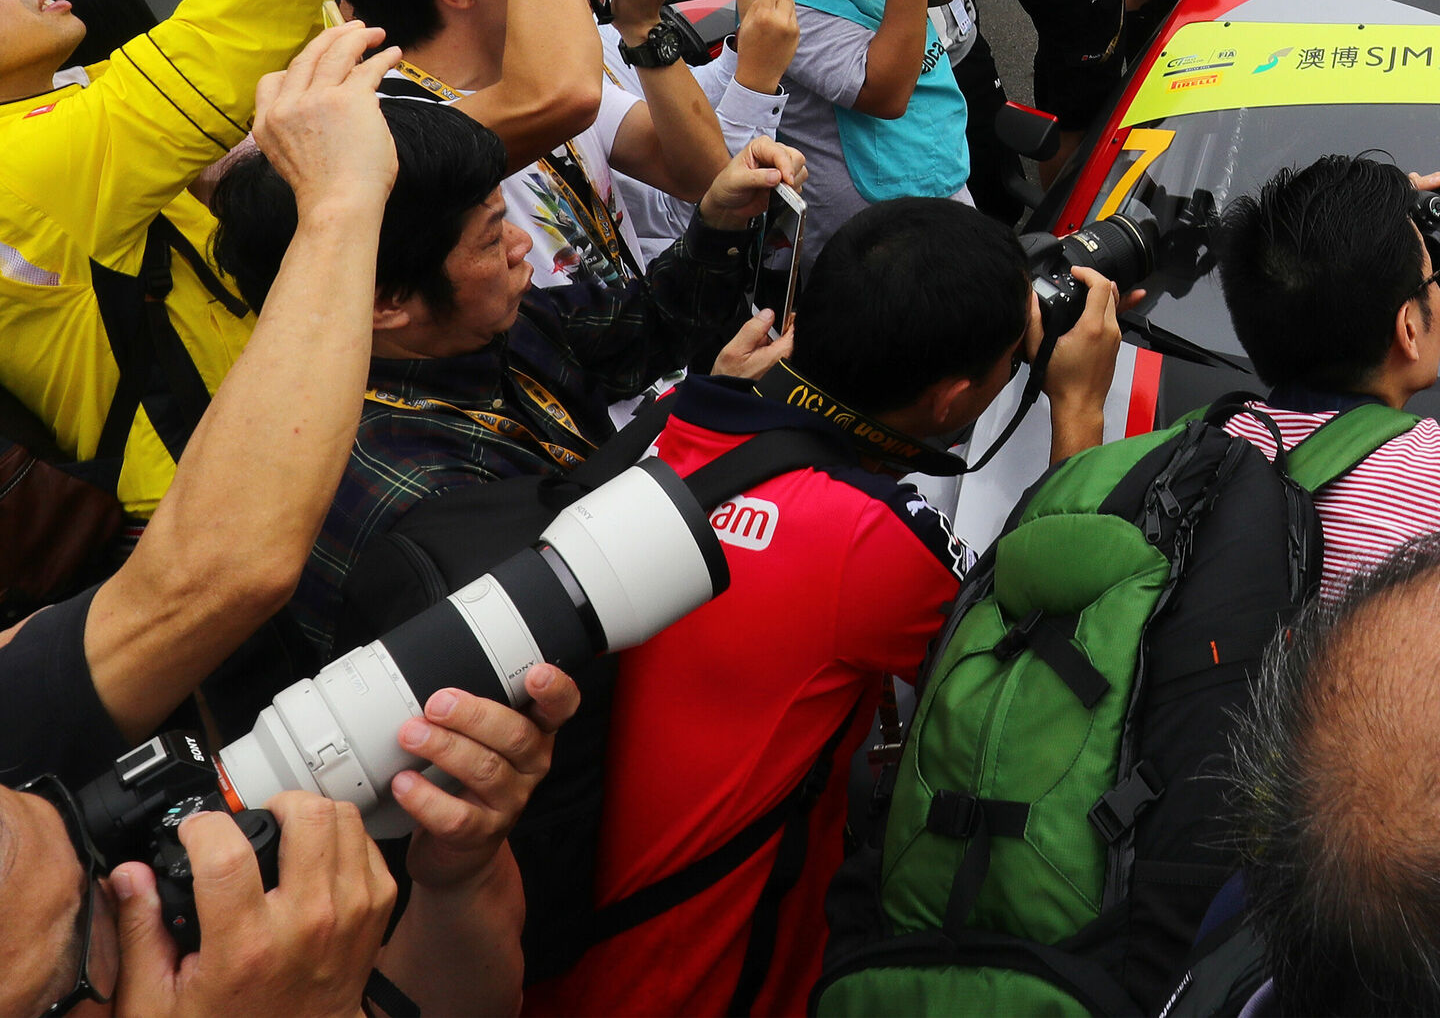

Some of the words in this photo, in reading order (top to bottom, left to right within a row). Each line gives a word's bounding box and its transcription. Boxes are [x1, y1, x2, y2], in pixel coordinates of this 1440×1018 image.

[1217, 50, 1235, 59] FIA
[1296, 46, 1360, 70] 澳博
[1365, 46, 1433, 73] SJM
[420, 76, 443, 91] 63
[1170, 75, 1218, 90] PIRELLI
[1096, 128, 1176, 221] 7
[853, 421, 922, 459] Nikon
[506, 659, 536, 680] SONY
[184, 734, 206, 763] SONY
